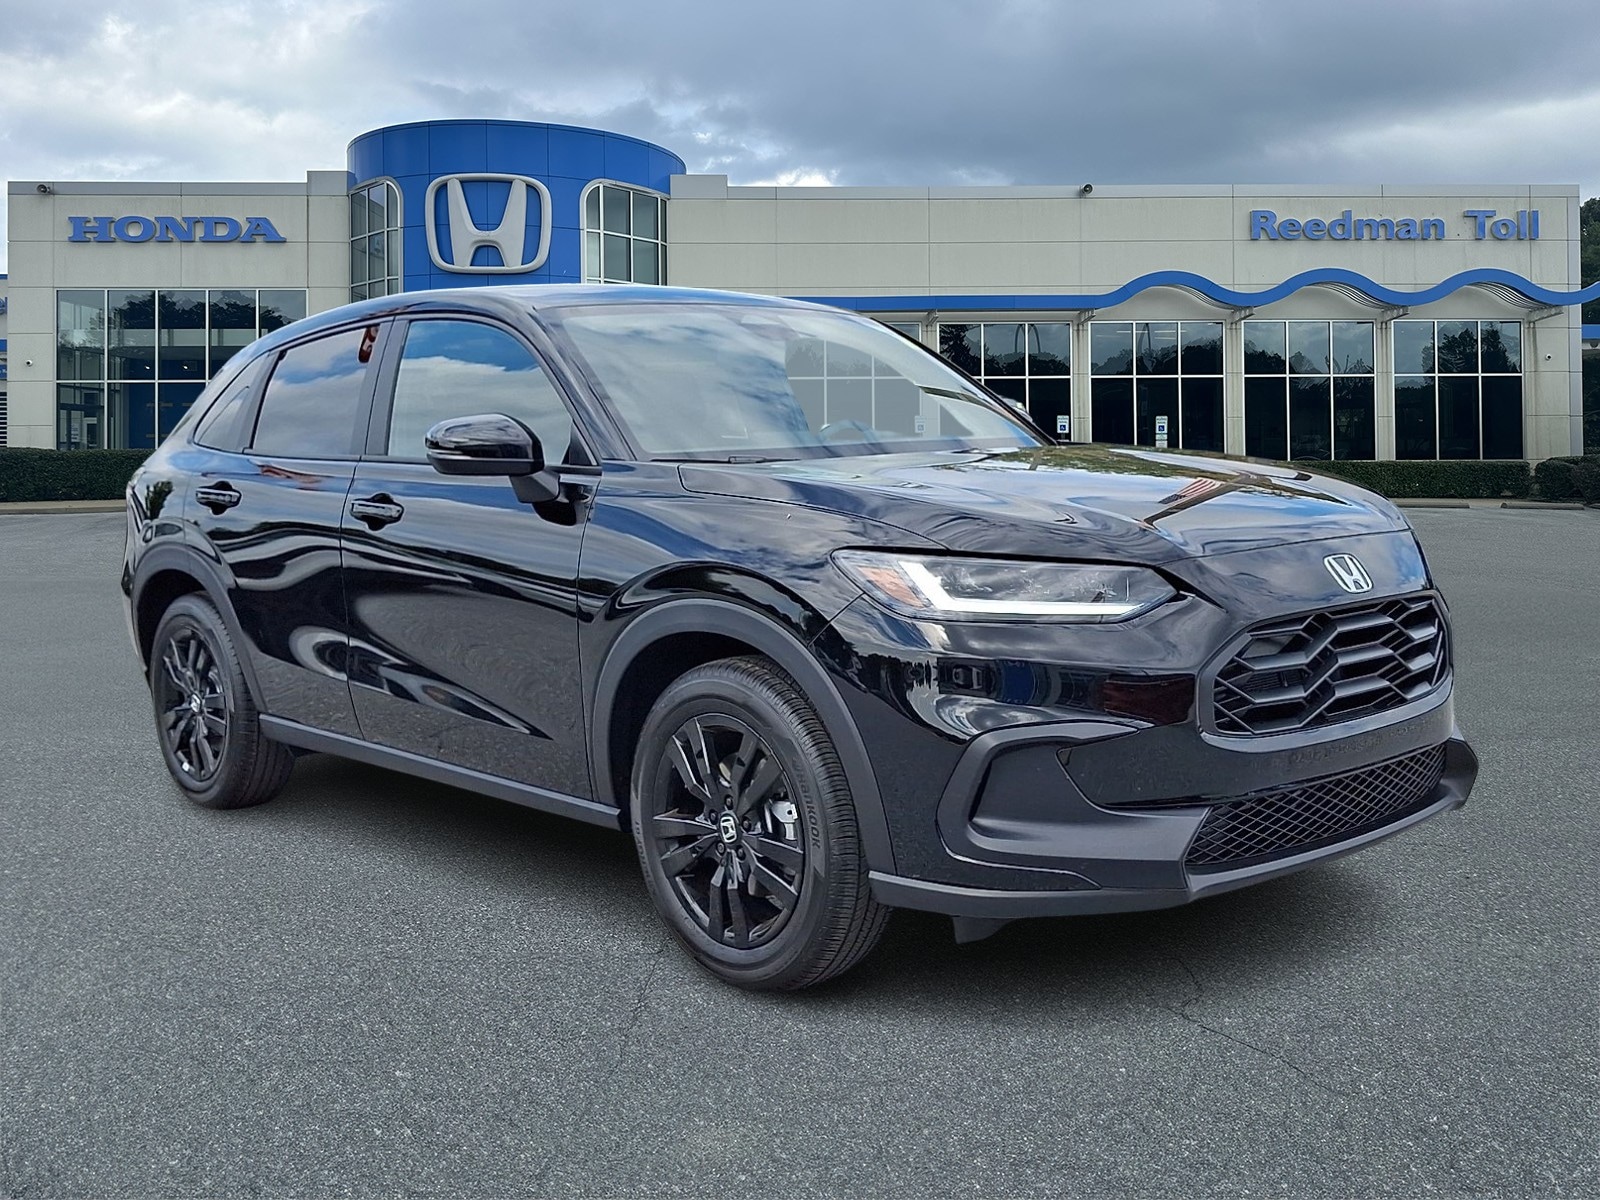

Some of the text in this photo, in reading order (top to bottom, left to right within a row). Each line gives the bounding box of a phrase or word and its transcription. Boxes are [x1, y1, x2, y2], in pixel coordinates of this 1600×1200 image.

[68, 215, 287, 243] HONDA
[1250, 209, 1540, 241] Reedman Toll
